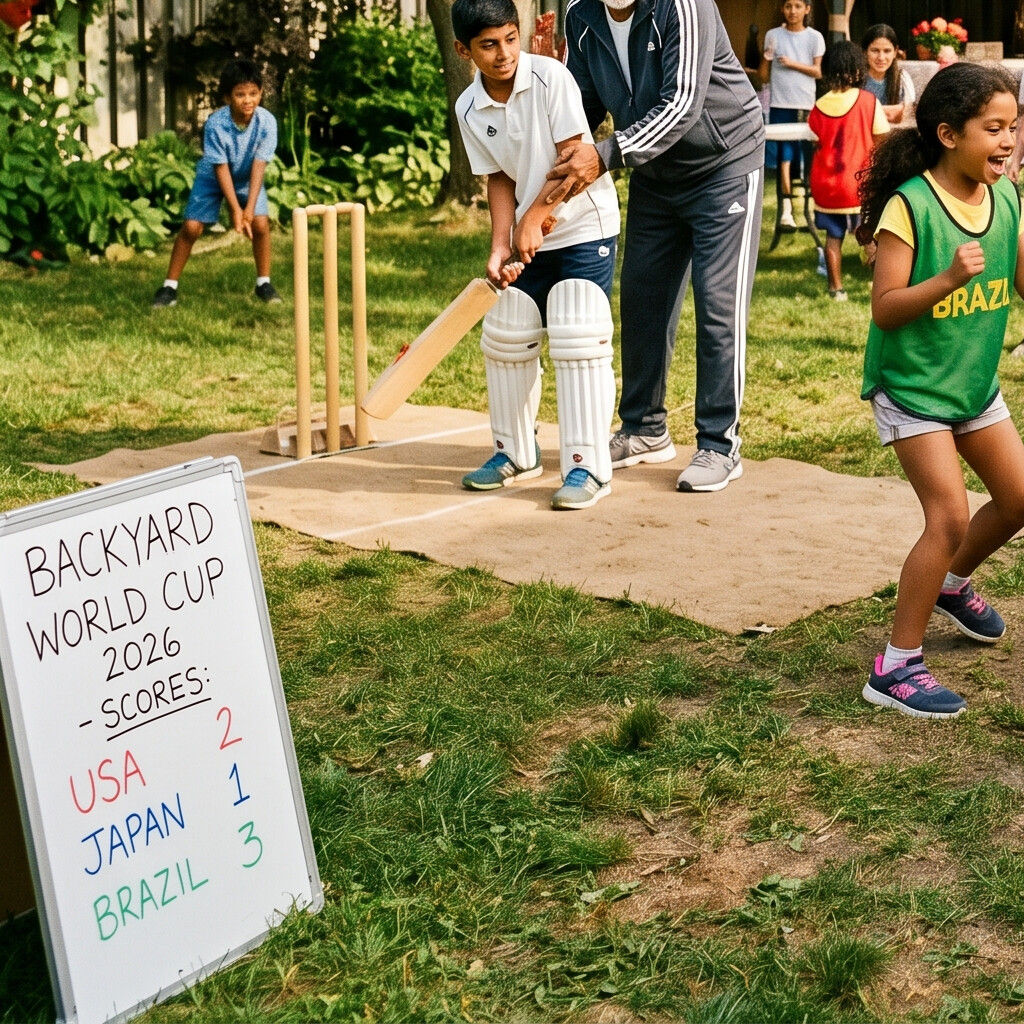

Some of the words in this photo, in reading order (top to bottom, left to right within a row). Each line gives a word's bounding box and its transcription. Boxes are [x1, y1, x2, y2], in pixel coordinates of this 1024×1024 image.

[25, 502, 213, 597] BACKYARD
[27, 588, 147, 662] WORLD
[163, 557, 224, 610] CUP
[103, 626, 181, 682] 2026
[101, 666, 211, 729] SCORES:
[69, 750, 147, 815] USA
[216, 706, 243, 751] 2
[81, 793, 185, 876] JAPAN
[229, 762, 250, 807] 1
[93, 858, 209, 942] BRAZIL
[238, 821, 263, 869] 3
